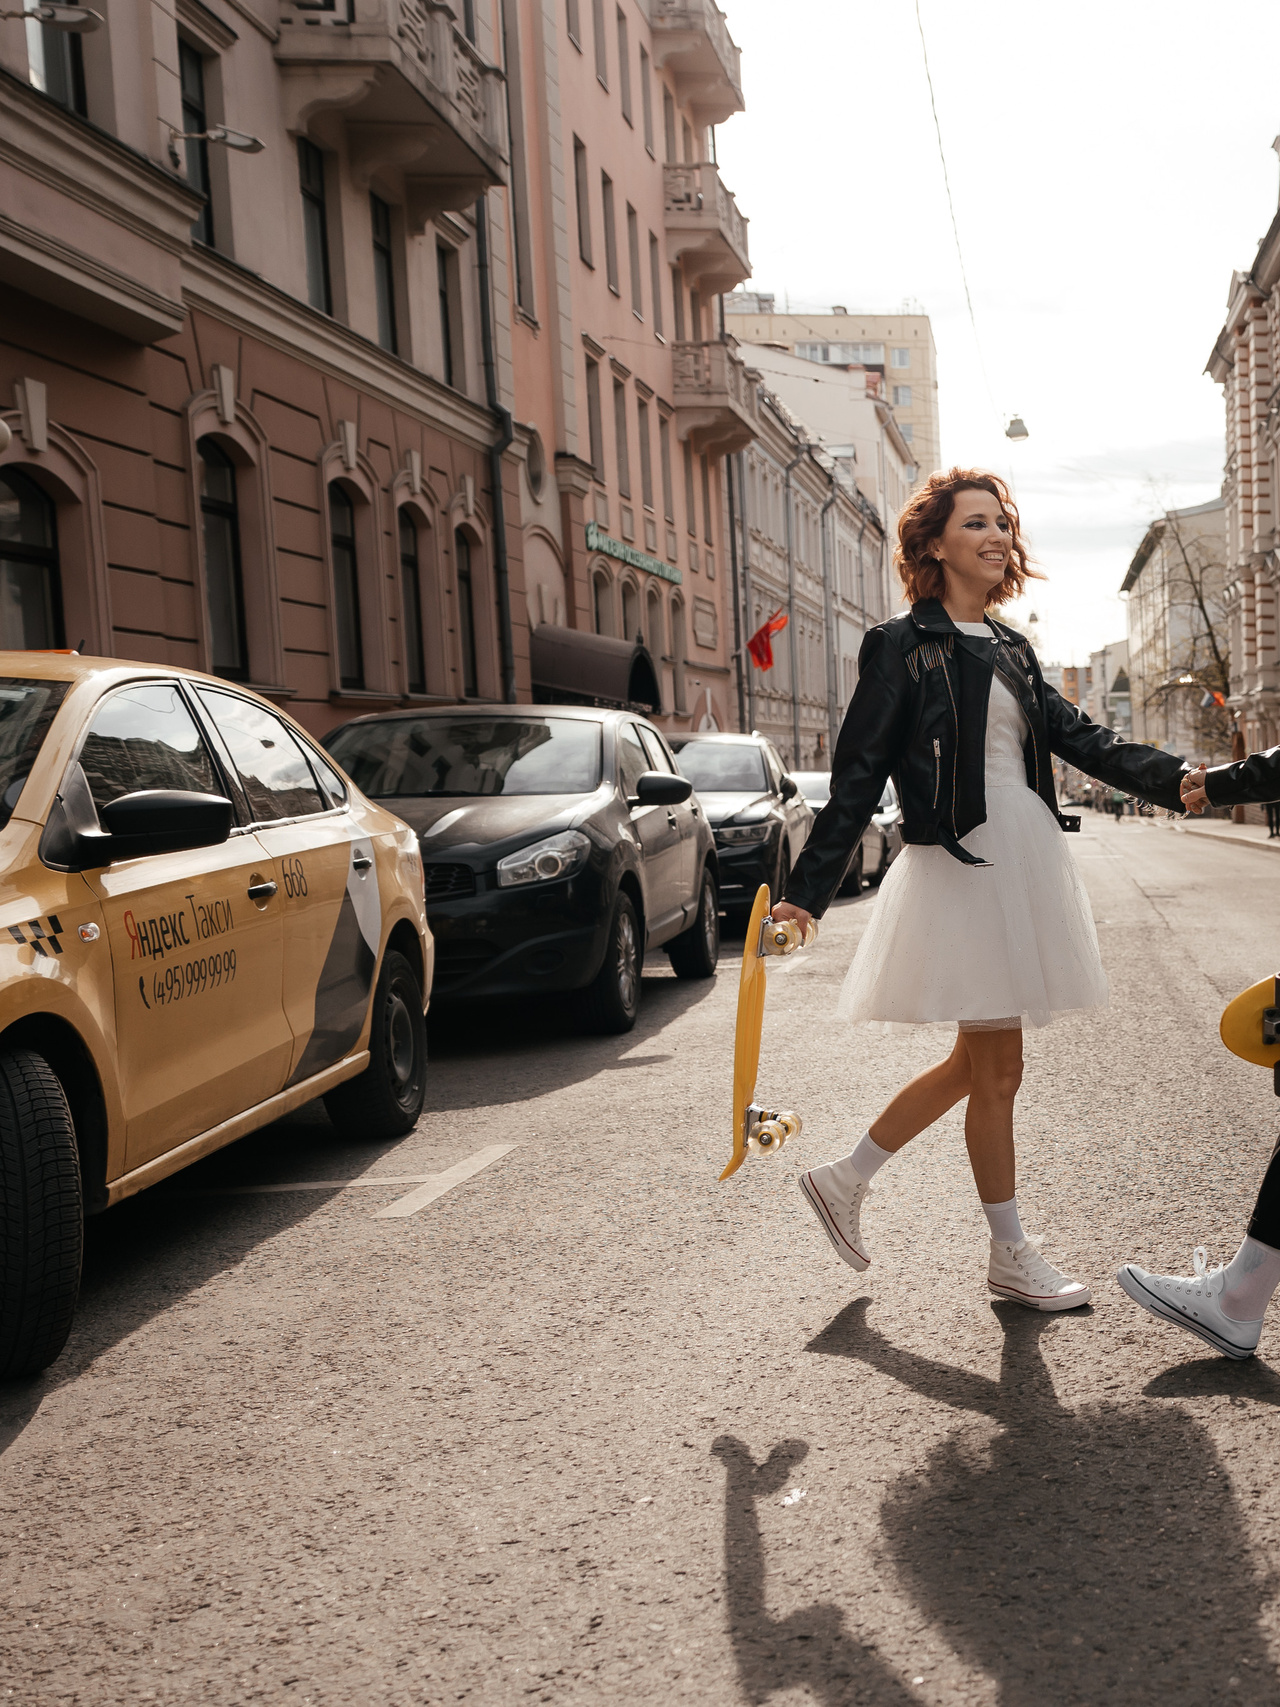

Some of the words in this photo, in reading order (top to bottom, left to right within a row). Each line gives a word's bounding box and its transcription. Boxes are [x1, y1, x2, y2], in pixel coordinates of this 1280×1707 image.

[282, 858, 308, 898] 668
[124, 910, 190, 960] Яндекс
[185, 894, 235, 941] Такси
